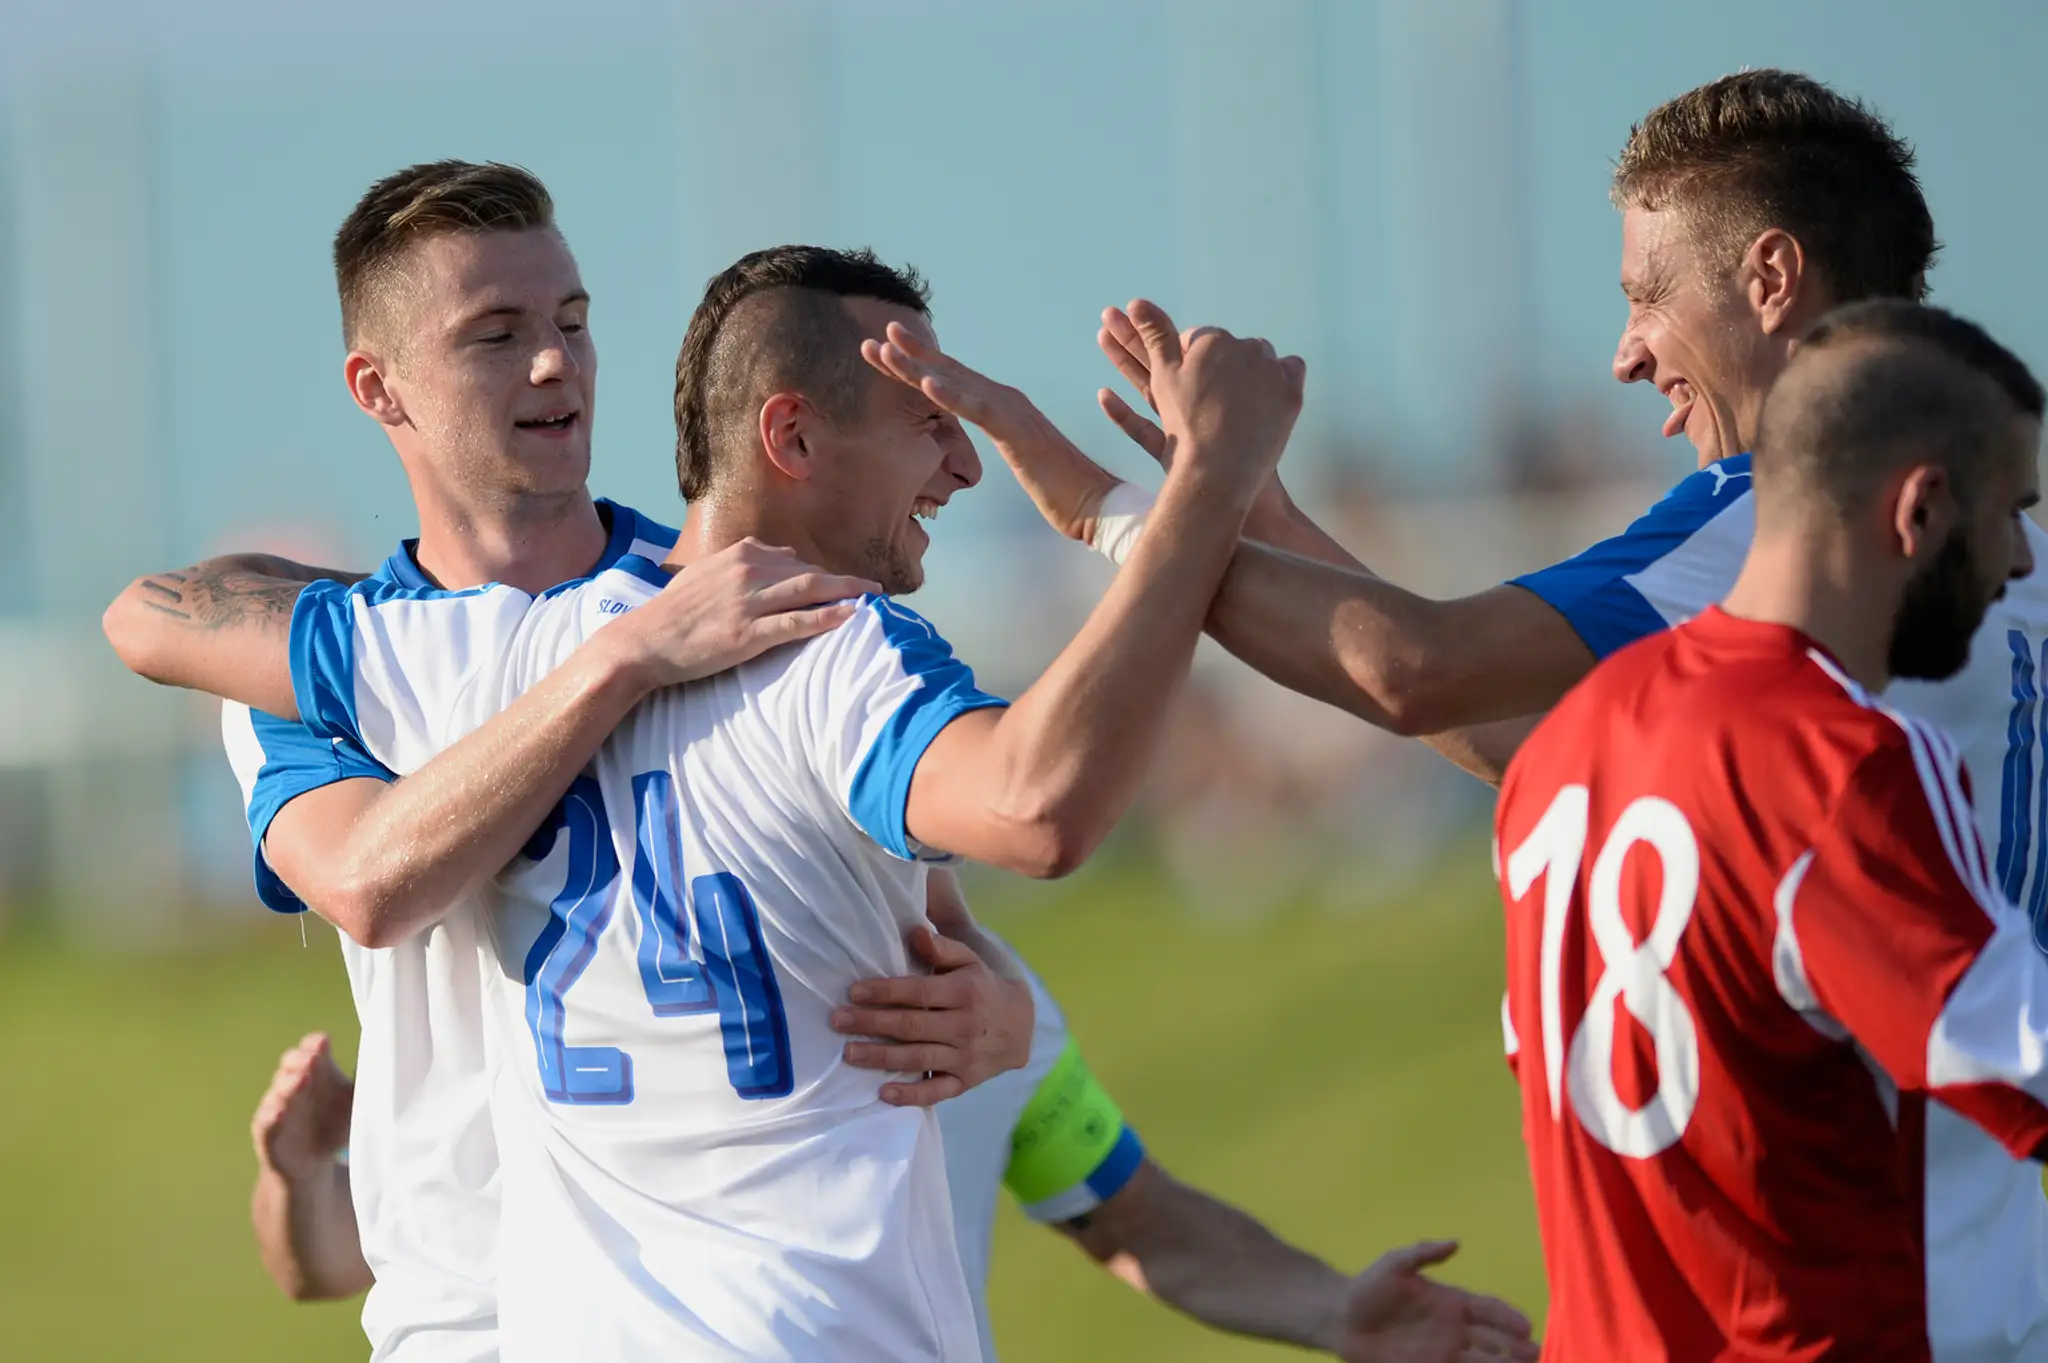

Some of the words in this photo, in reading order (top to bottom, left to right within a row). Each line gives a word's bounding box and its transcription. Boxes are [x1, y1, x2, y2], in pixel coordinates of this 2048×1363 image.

[598, 599, 634, 614] SLOV
[522, 770, 794, 1105] 24
[1507, 784, 1700, 1159] 18
